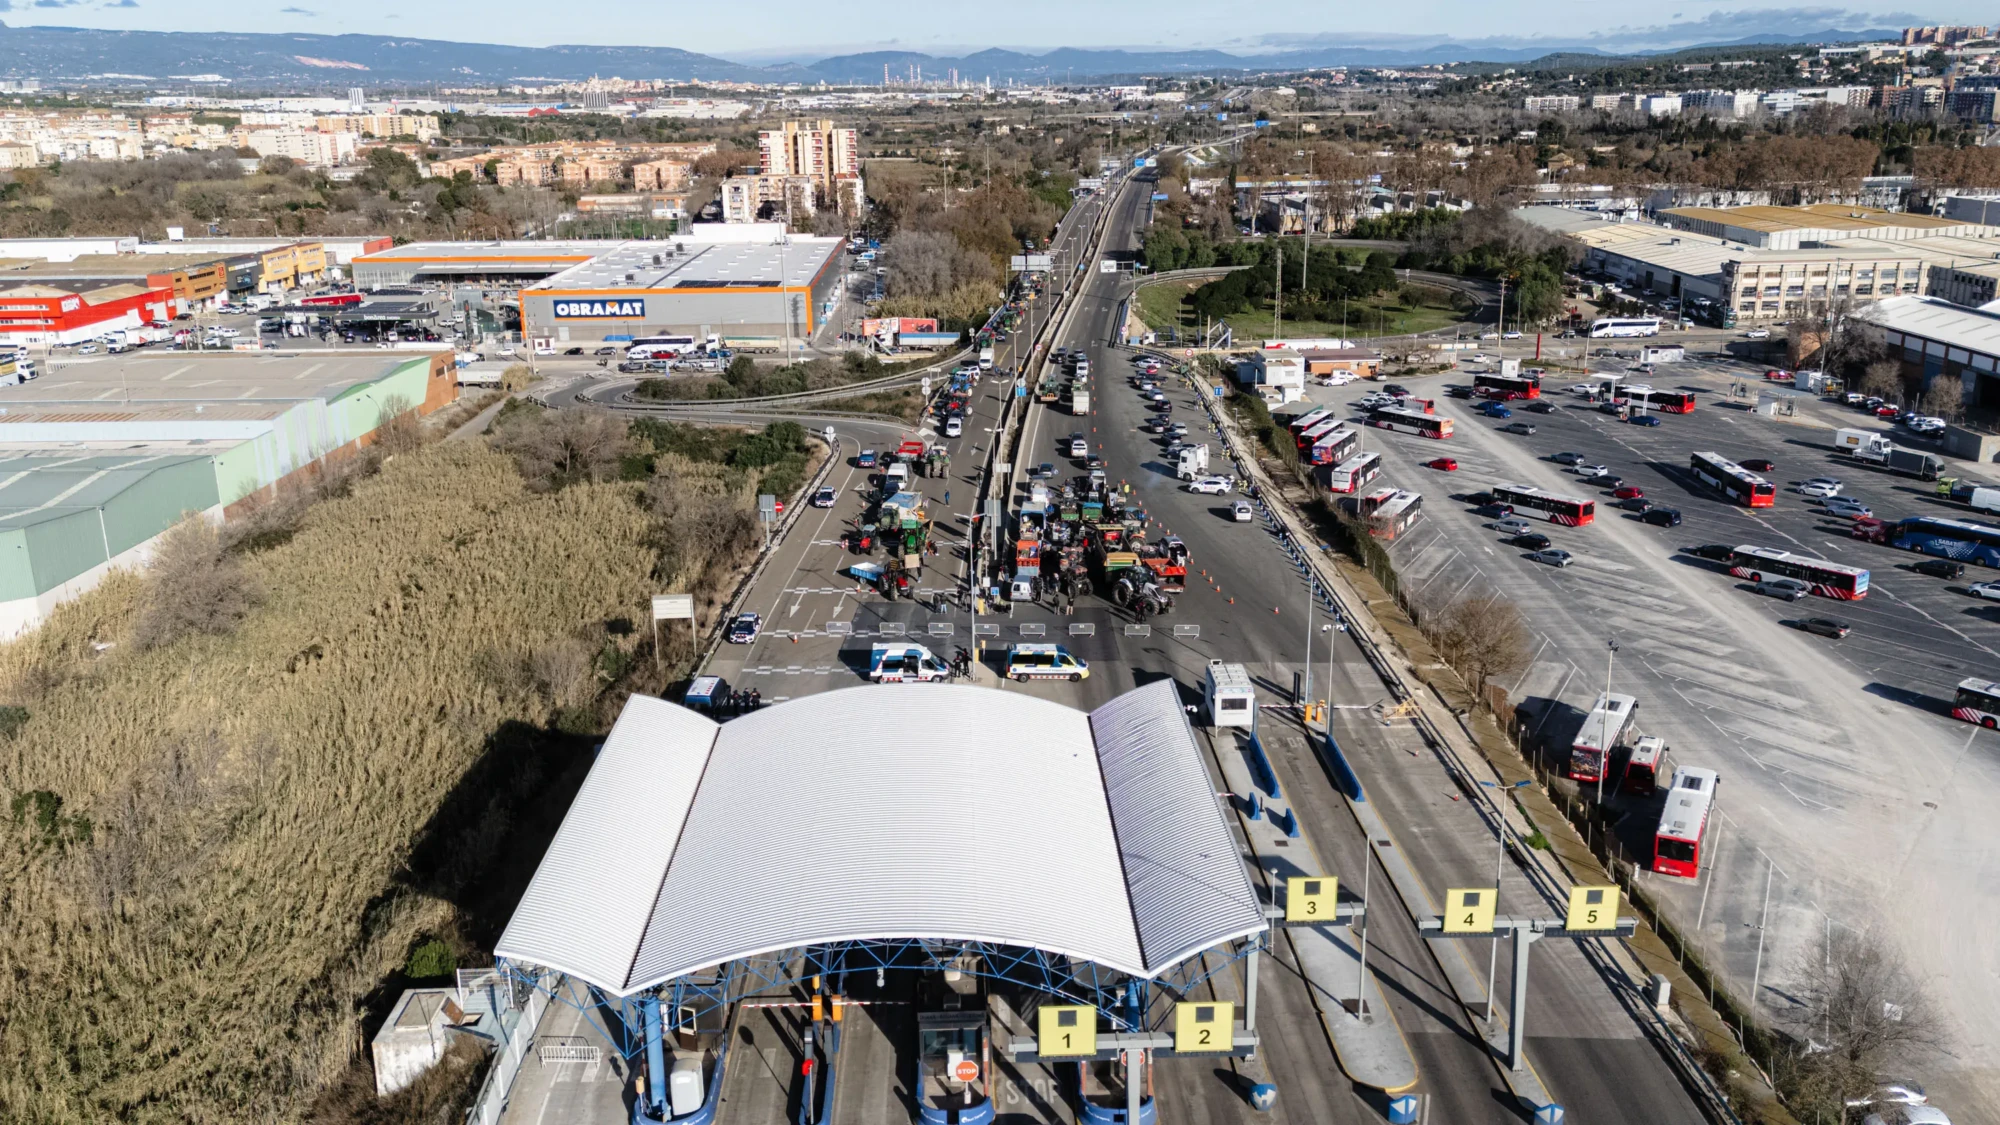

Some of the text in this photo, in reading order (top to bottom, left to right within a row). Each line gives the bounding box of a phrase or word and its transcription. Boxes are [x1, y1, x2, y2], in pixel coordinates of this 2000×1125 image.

[556, 302, 642, 316] OBRAMAT
[1306, 901, 1317, 915] 3
[1463, 912, 1475, 926] 4
[1587, 910, 1598, 924] 5
[1062, 1033, 1070, 1049] 1
[1199, 1029, 1211, 1045] 2
